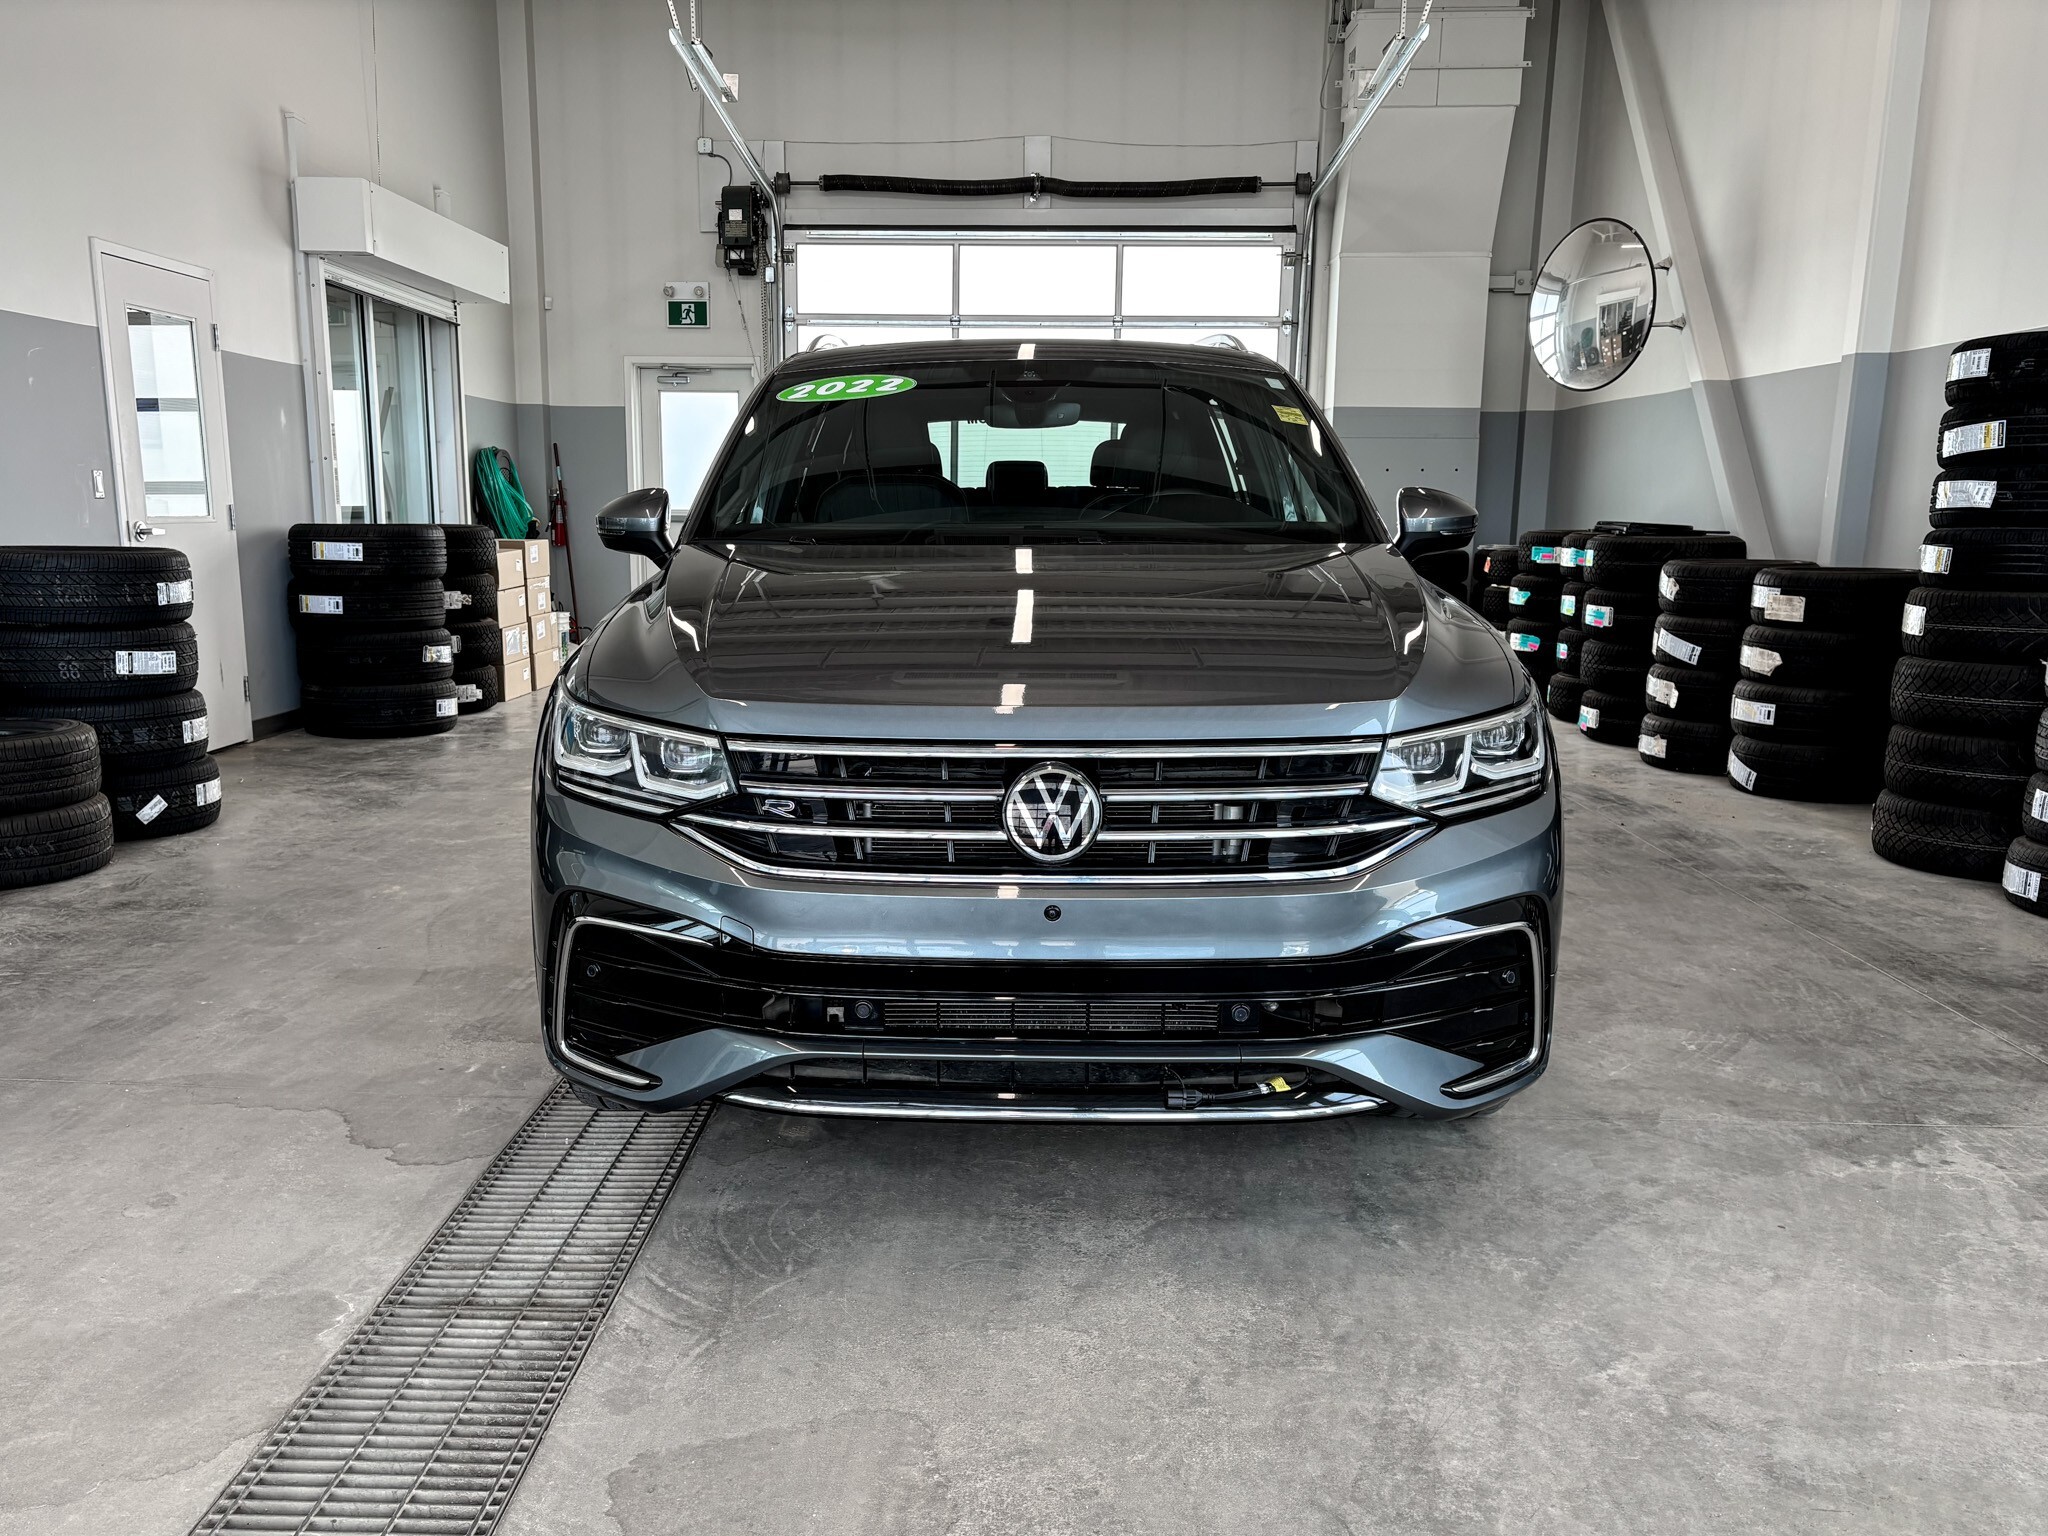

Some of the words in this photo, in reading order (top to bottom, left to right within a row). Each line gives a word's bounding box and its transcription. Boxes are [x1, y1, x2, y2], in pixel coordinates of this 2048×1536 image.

[787, 378, 904, 400] 2022
[762, 799, 797, 819] R
[1008, 770, 1097, 856] VW
